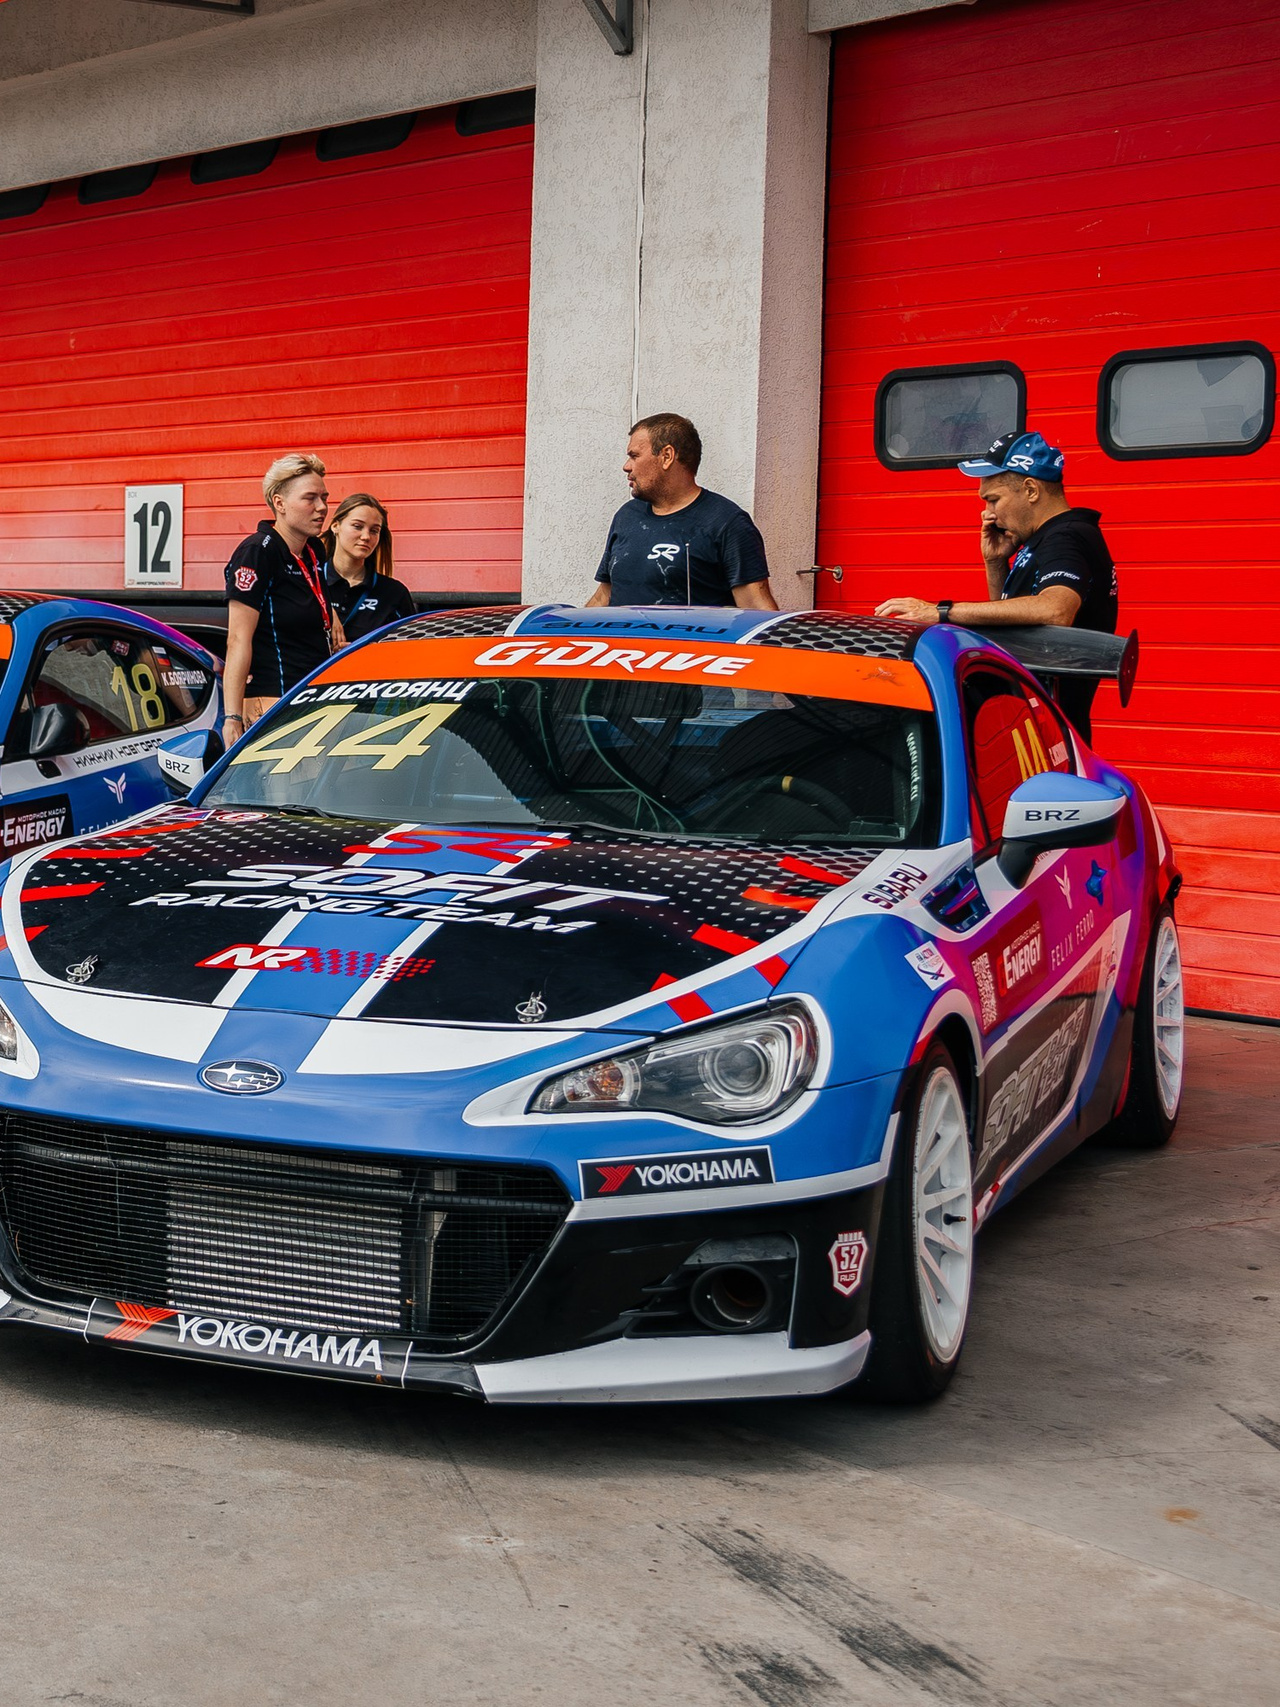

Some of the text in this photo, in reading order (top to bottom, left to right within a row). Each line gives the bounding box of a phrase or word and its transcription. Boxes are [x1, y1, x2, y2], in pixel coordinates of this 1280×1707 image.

[1007, 454, 1034, 472] SR
[133, 501, 172, 573] 12
[647, 543, 680, 561] SR
[239, 573, 252, 584] 52
[542, 620, 728, 635] SUBARU
[474, 641, 755, 675] G-DRIVE
[160, 670, 208, 687] К.БОЯРИНОВА
[111, 663, 166, 732] 18
[291, 680, 477, 704] С.ИСКОЯНЦ
[228, 703, 462, 774] 44
[73, 749, 118, 768] НИЖНИЙ
[165, 758, 191, 775] BRZ
[1024, 809, 1081, 821] BRZ
[342, 828, 572, 863] SR
[184, 864, 672, 912] SOFIT
[861, 862, 928, 910] SUBARU
[128, 892, 598, 934] RACING TEAM
[206, 945, 314, 969] NR
[1050, 932, 1074, 972] FELIX
[634, 1157, 760, 1187] YOKOHAMA
[840, 1245, 860, 1271] 52
[839, 1272, 856, 1283] RUS
[176, 1313, 383, 1372] YOKOHAMA
